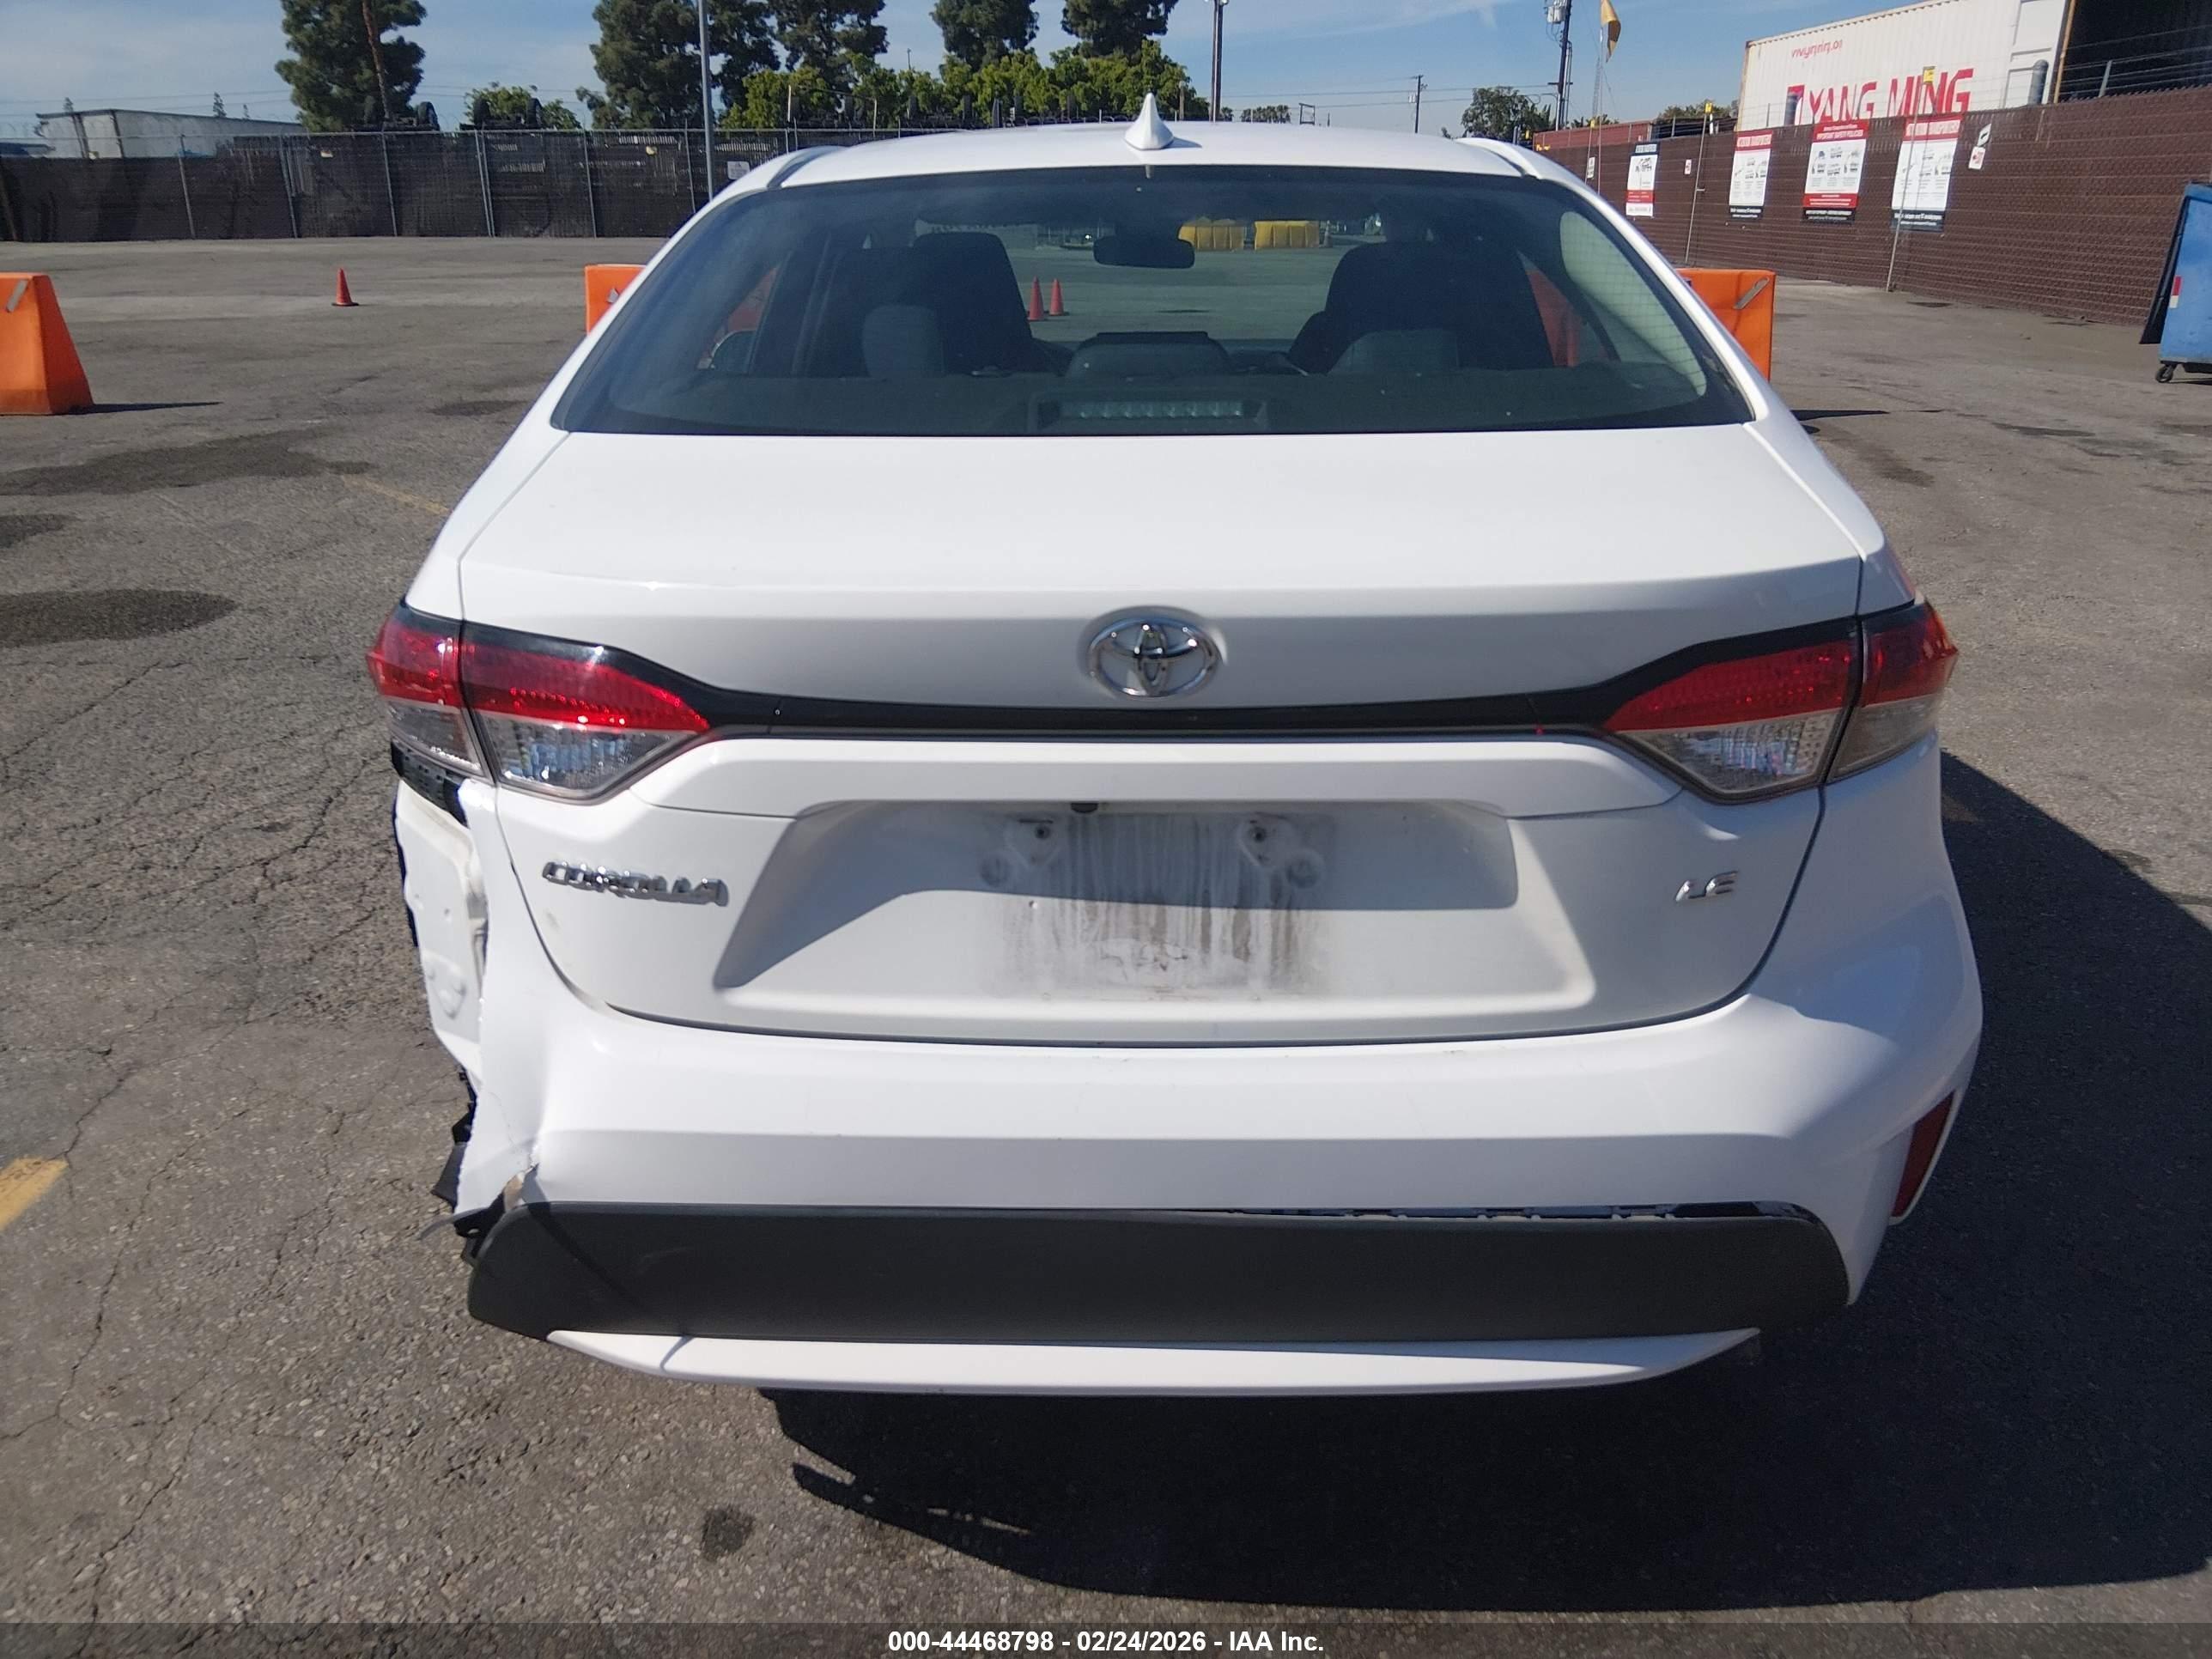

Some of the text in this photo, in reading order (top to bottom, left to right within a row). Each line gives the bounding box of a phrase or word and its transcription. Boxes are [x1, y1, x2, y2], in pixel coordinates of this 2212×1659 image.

[1809, 68, 1974, 124] YANG MING
[542, 860, 729, 907] COROLLA
[1673, 869, 1739, 904] LE
